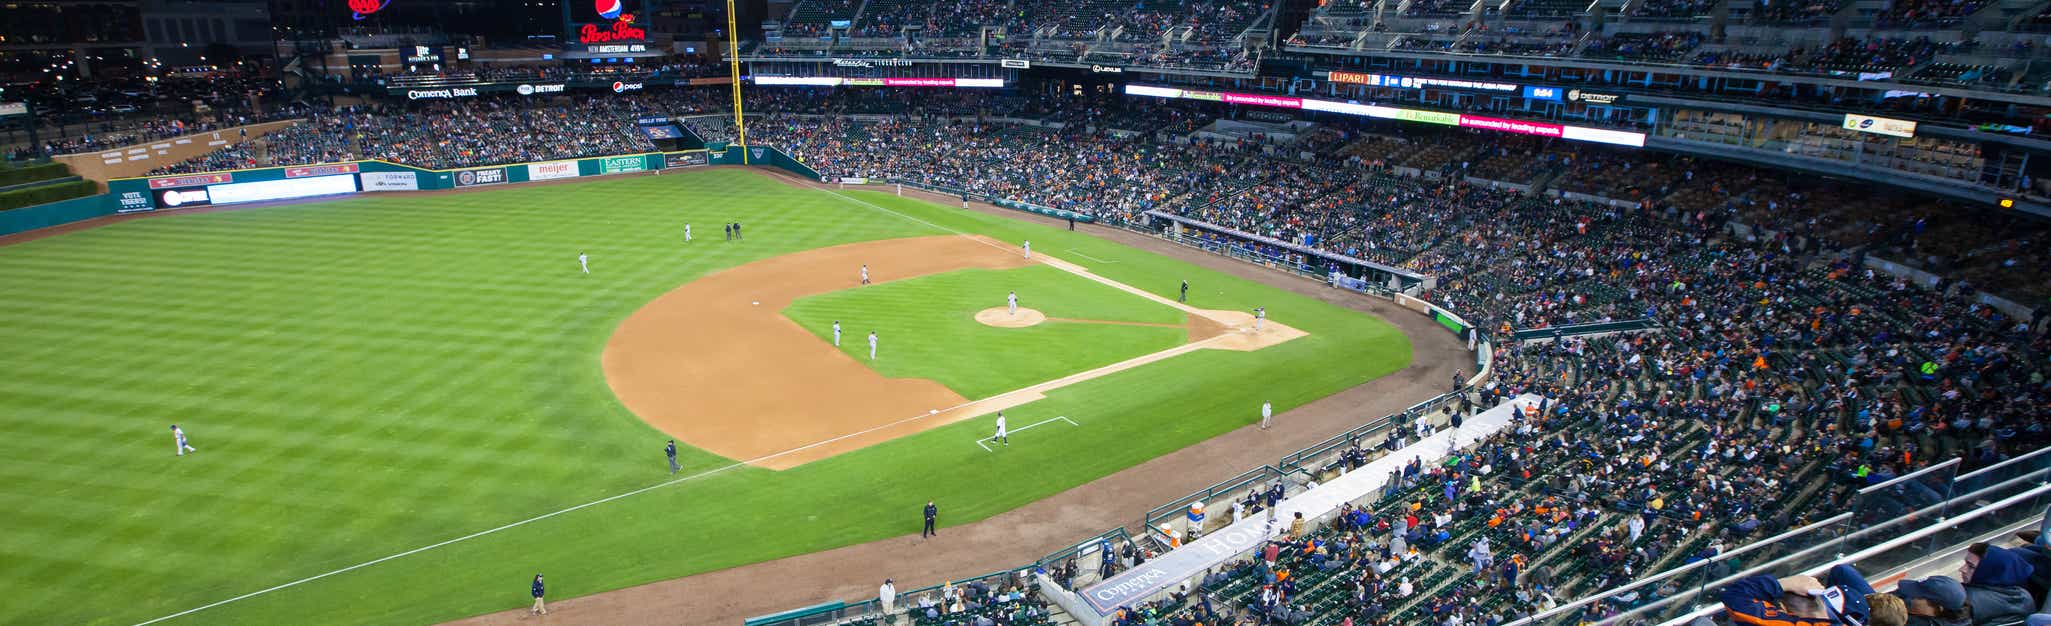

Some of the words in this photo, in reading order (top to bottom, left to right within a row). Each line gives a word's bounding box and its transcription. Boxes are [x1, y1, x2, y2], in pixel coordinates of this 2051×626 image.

[1334, 73, 1364, 83] LIPARI
[535, 84, 565, 93] DETROIT
[624, 82, 643, 91] pepsi
[453, 88, 477, 98] Bank
[1580, 92, 1619, 101] DETROIT
[1470, 118, 1502, 128] surrounded
[1511, 122, 1535, 133] leading
[605, 157, 641, 167] EASTERN
[539, 162, 568, 173] meijer
[476, 169, 501, 177] FREAKY
[476, 174, 502, 183] FAST!
[122, 191, 141, 199] VOTE
